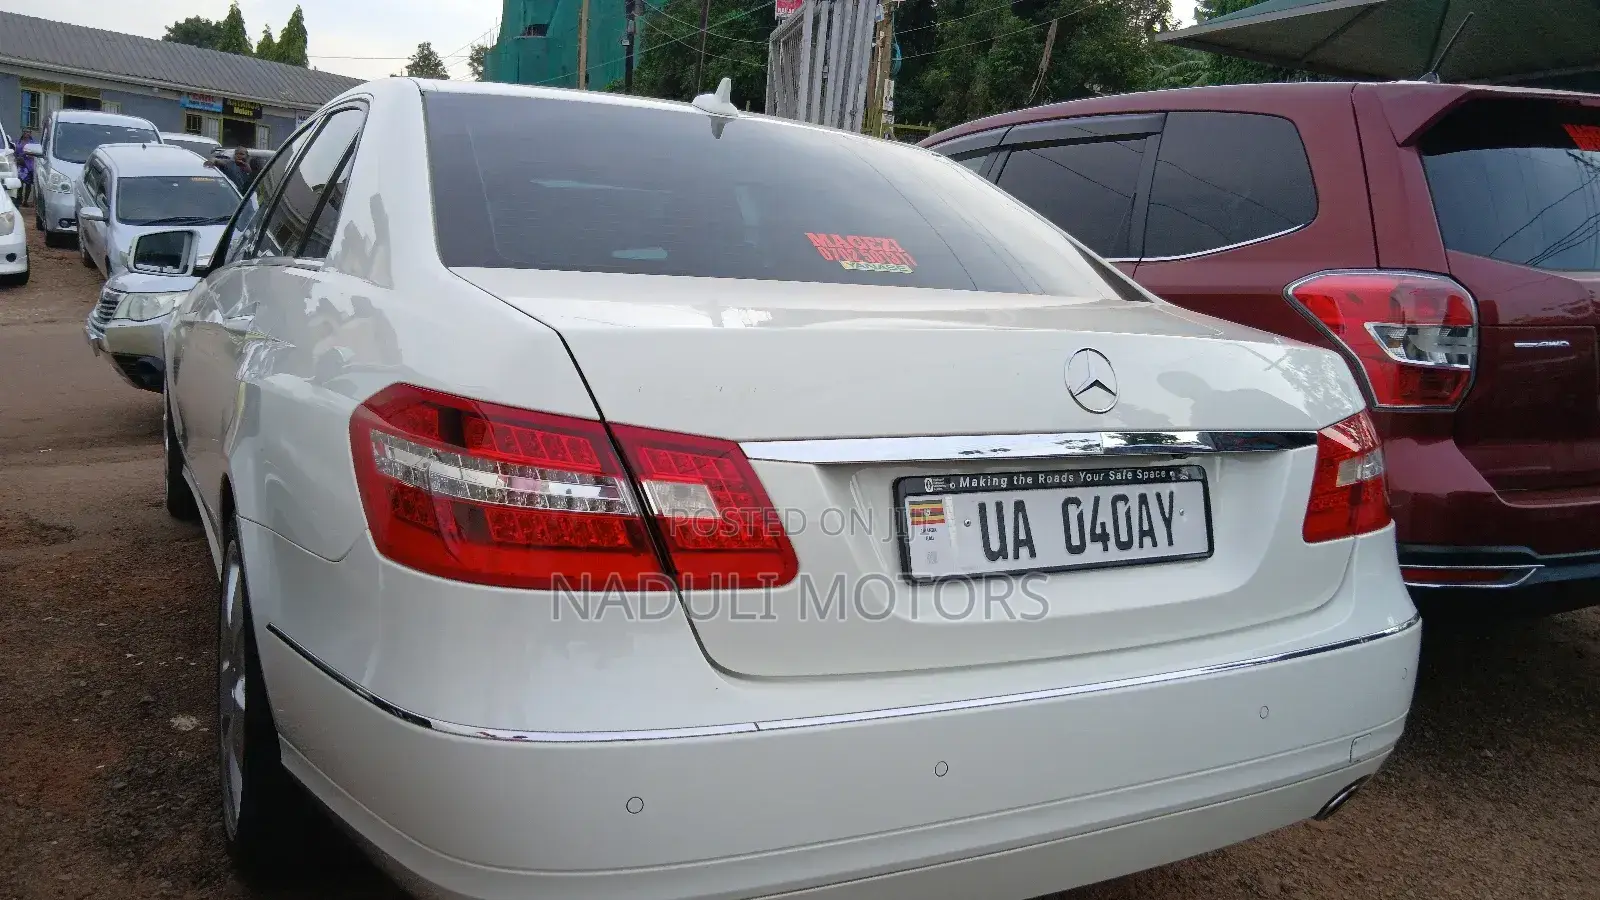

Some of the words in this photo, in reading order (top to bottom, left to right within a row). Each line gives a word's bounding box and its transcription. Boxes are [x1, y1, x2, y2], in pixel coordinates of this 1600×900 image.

[959, 475, 1009, 489] Making
[1013, 473, 1034, 485] the
[1038, 472, 1074, 484] Roads
[1078, 470, 1105, 482] Your
[1109, 469, 1133, 481] Safe
[1136, 468, 1167, 482] Space
[978, 500, 1037, 562] UA
[1061, 490, 1175, 555] 040AY
